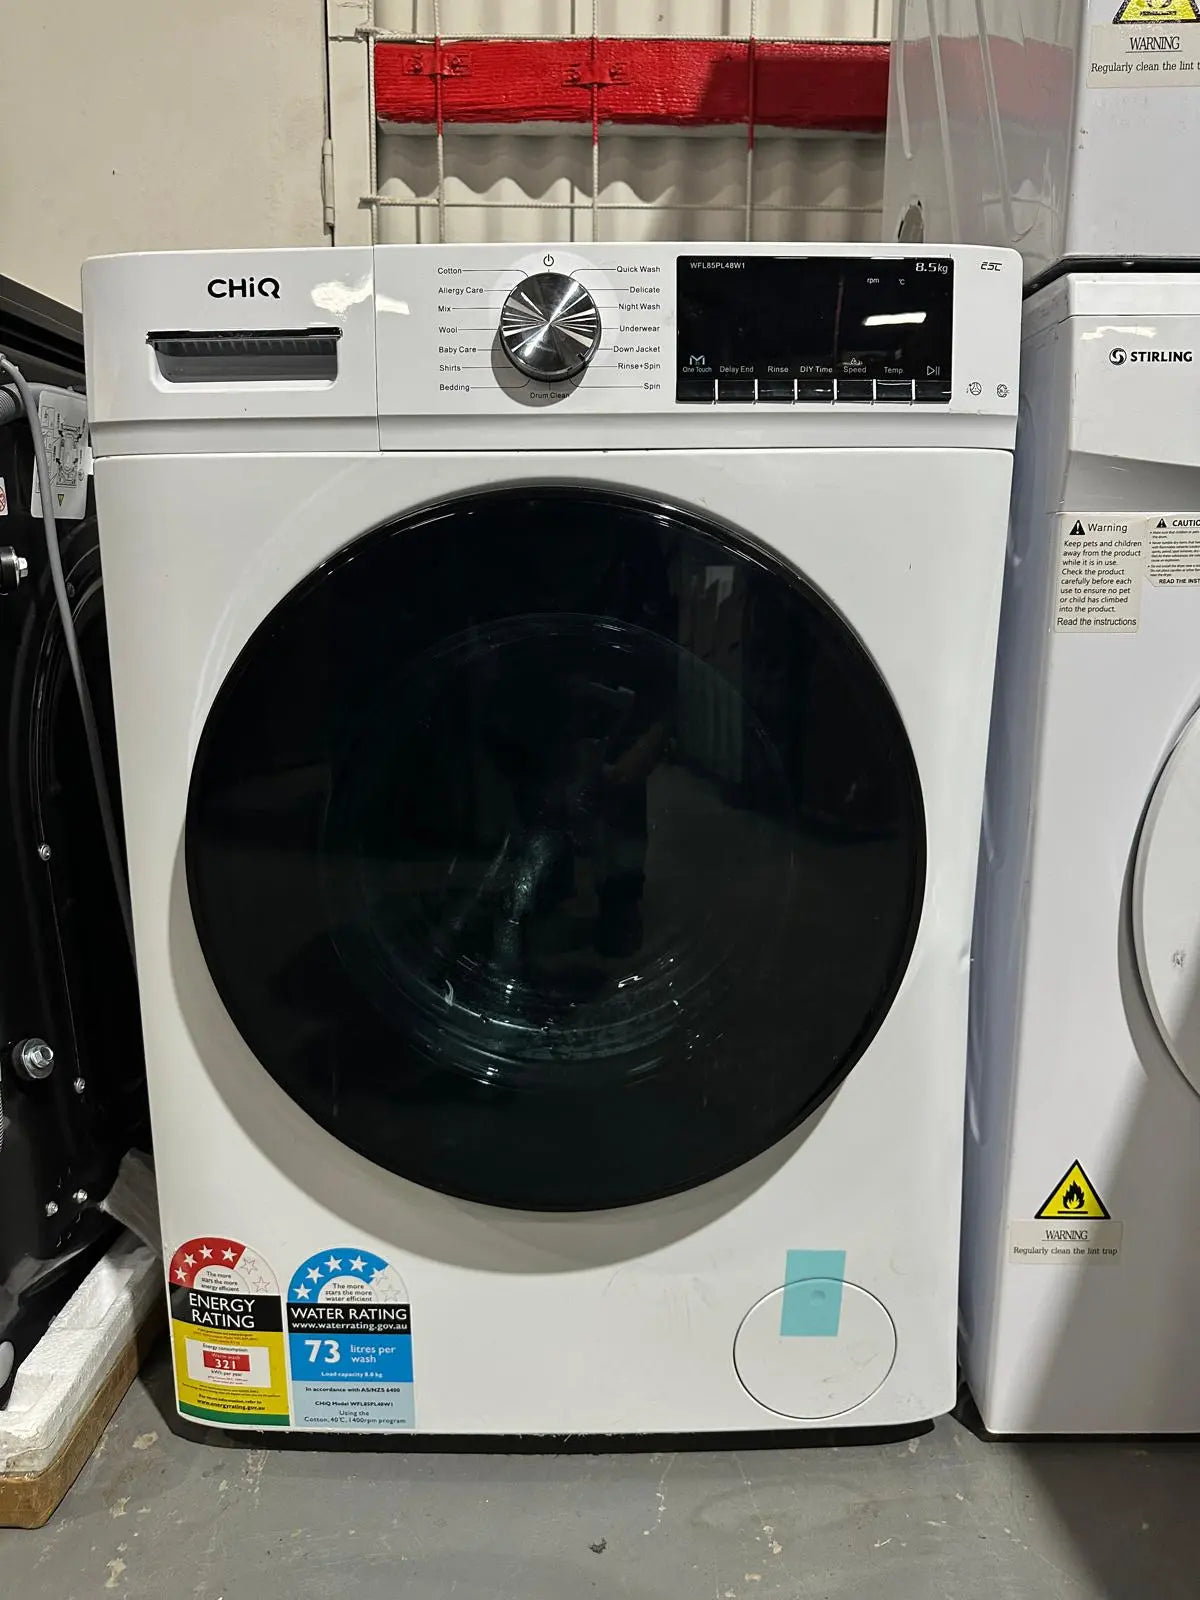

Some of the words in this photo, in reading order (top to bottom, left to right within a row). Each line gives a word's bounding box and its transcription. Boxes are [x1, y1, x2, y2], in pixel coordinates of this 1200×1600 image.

[1130, 36, 1180, 50] WARNING
[1091, 62, 1133, 74] Regularly
[1136, 61, 1159, 70] clean
[1162, 61, 1176, 70] the
[1180, 61, 1194, 70] lint
[208, 277, 280, 299] CHiQ
[636, 345, 660, 353] Jacket
[1131, 351, 1192, 362] STIRLING
[720, 366, 739, 374] Delay
[440, 384, 470, 392] Bedding
[1088, 523, 1128, 533] Warning
[1064, 540, 1081, 548] Keep
[1061, 578, 1090, 586] carefully
[1057, 618, 1077, 626] Read
[1094, 618, 1137, 626] instructions
[1046, 1230, 1088, 1240] WARNING
[1014, 1247, 1048, 1255] Regularly
[1102, 1247, 1117, 1255] trap
[189, 1293, 255, 1312] ENERGY
[192, 1309, 255, 1328] RATING
[290, 1308, 344, 1320] WATER
[349, 1308, 407, 1319] RATING
[292, 1322, 407, 1331] www.waterrating.gov.au
[305, 1339, 341, 1363] 73
[350, 1345, 376, 1354] litres
[378, 1347, 396, 1355] per
[215, 1358, 236, 1369] 321
[351, 1355, 376, 1363] wash
